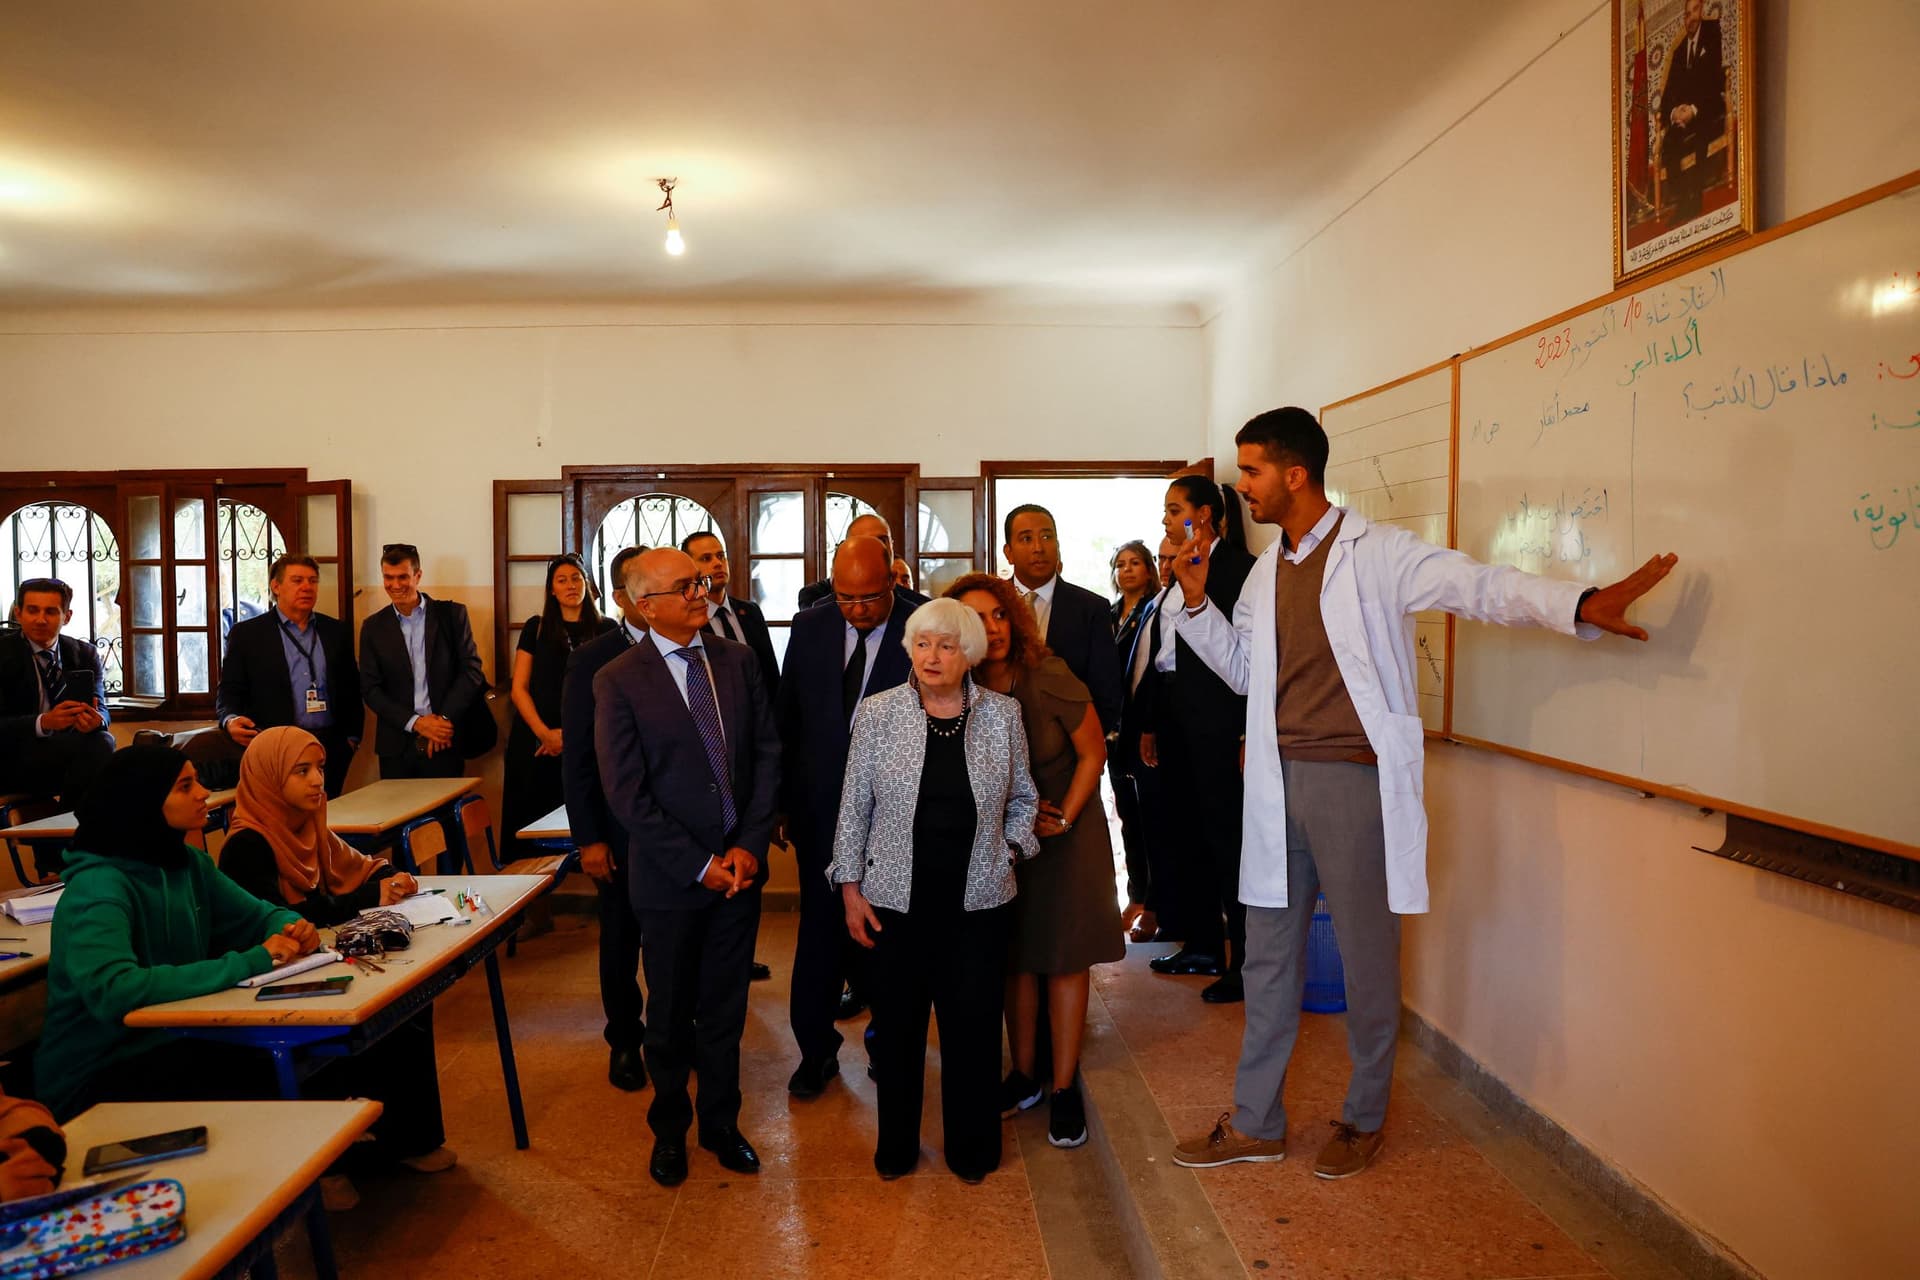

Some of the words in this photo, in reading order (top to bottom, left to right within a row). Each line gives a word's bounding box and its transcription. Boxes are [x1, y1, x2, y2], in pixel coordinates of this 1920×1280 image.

[1623, 296, 1642, 334] 10
[1535, 327, 1571, 369] 2023
[1749, 364, 1797, 410] قال
[1801, 353, 1848, 389] ماذا
